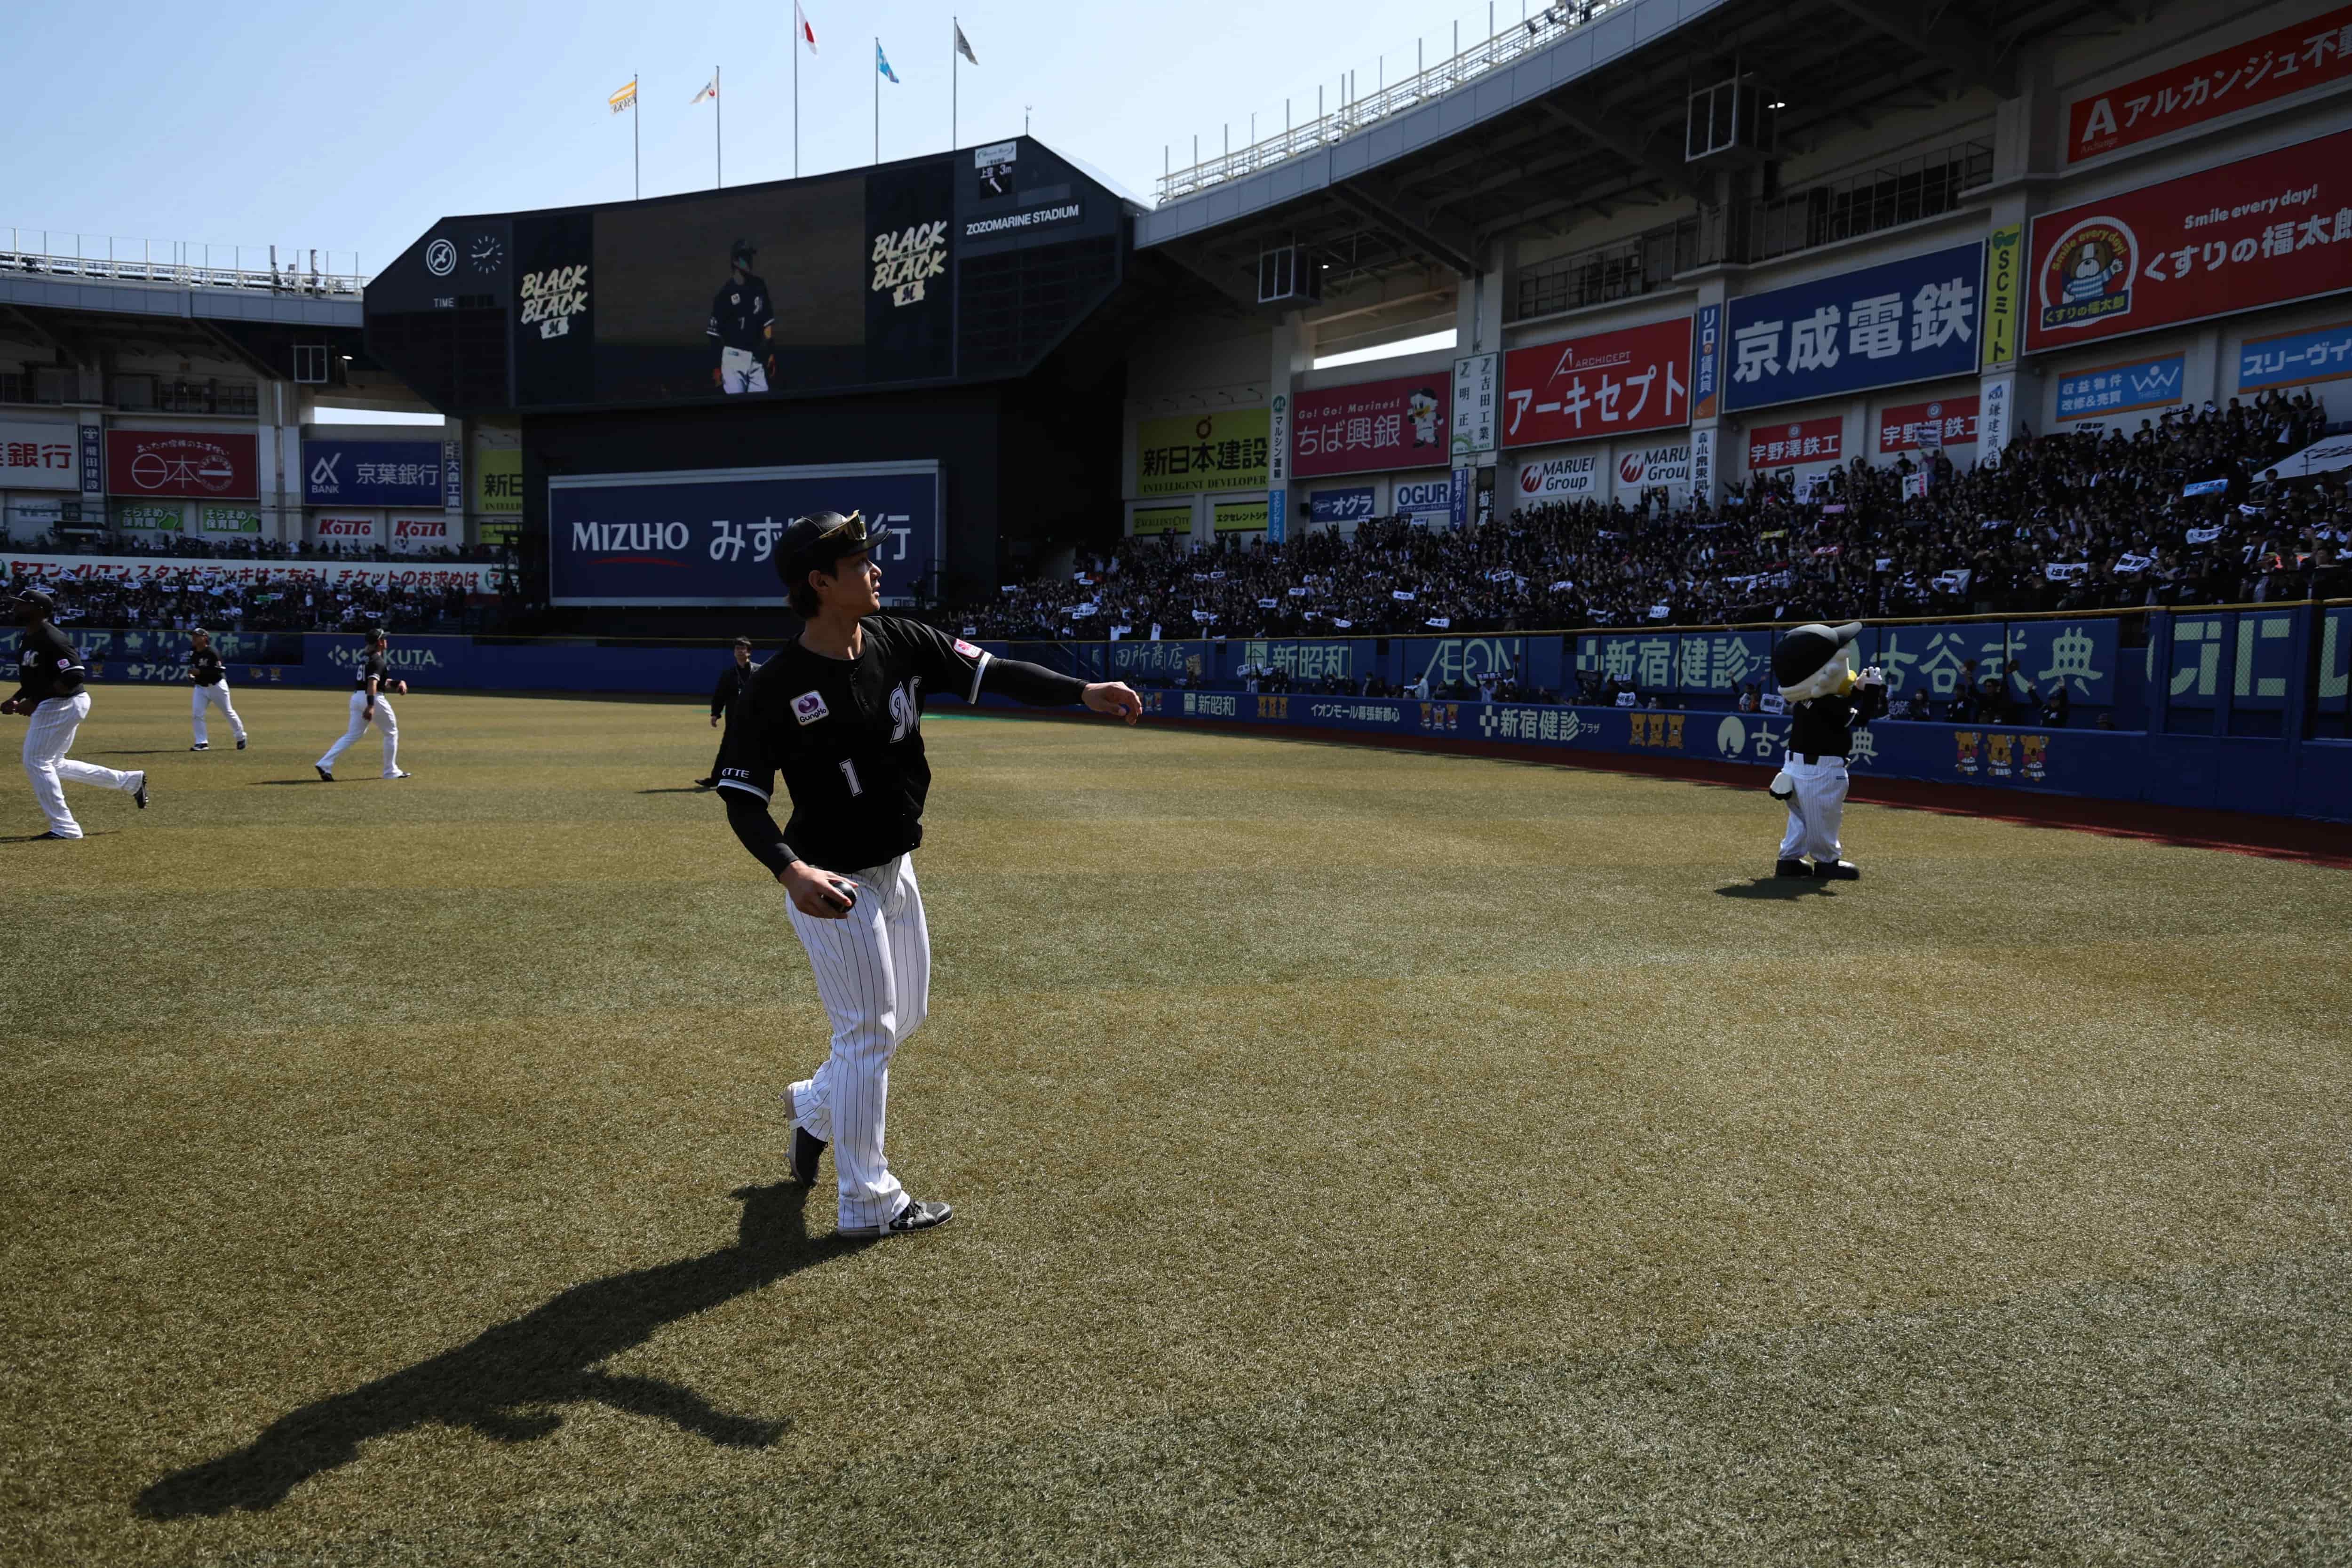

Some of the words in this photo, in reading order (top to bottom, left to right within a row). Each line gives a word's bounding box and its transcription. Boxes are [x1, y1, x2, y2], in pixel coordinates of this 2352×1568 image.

[999, 164, 1012, 175] 3m
[1032, 204, 1080, 223] STADIUM
[2184, 207, 2229, 230] Smile
[2231, 196, 2278, 220] every
[2280, 183, 2318, 207] day!
[872, 220, 947, 263] BLACK
[520, 264, 588, 298] BLACK
[871, 250, 947, 292] BLACK
[433, 297, 454, 308] TIME
[520, 292, 588, 324] BLACK
[1994, 250, 2010, 362] SCミート
[1732, 277, 1974, 383] 京成電鉄
[1575, 350, 1631, 369] ARCHICEPT
[1299, 409, 1317, 419] Go!
[1323, 405, 1343, 416] Go!
[1347, 398, 1400, 414] Marines!
[1459, 387, 1470, 427] 明正
[1479, 376, 1491, 441] 吉田工業
[1507, 360, 1685, 437] アーキセプト
[1297, 414, 1400, 456] ちば興銀
[1750, 434, 1839, 463] 宇野澤鉄工
[0, 442, 72, 470] 銀行
[1142, 438, 1268, 476] 新日本建設
[1542, 456, 1595, 476] MARUEI
[355, 463, 439, 486] 京葉銀行
[1143, 480, 1204, 493] INTELLIGENT
[1208, 475, 1267, 488] DEVELOPER
[1546, 476, 1588, 491] Group
[312, 485, 339, 493] BANK
[122, 507, 164, 517] そらまめ
[206, 509, 247, 519] そらまめ
[1332, 495, 1373, 516] オグラ
[122, 517, 158, 528] 保育園
[206, 519, 240, 530] 保育園
[572, 521, 690, 552] MIZUHO
[709, 514, 912, 563] みず行
[351, 648, 437, 666] KKUTA
[1114, 642, 1184, 671] 田所商店
[1272, 644, 1352, 680] 新昭和
[1869, 627, 2104, 696] 古谷式典
[800, 708, 826, 723] GungHo
[1198, 695, 1236, 716] 新昭和
[1311, 703, 1400, 723] イオンモール幕張新都心
[1750, 720, 1879, 765] 古典
[839, 757, 863, 798] 1
